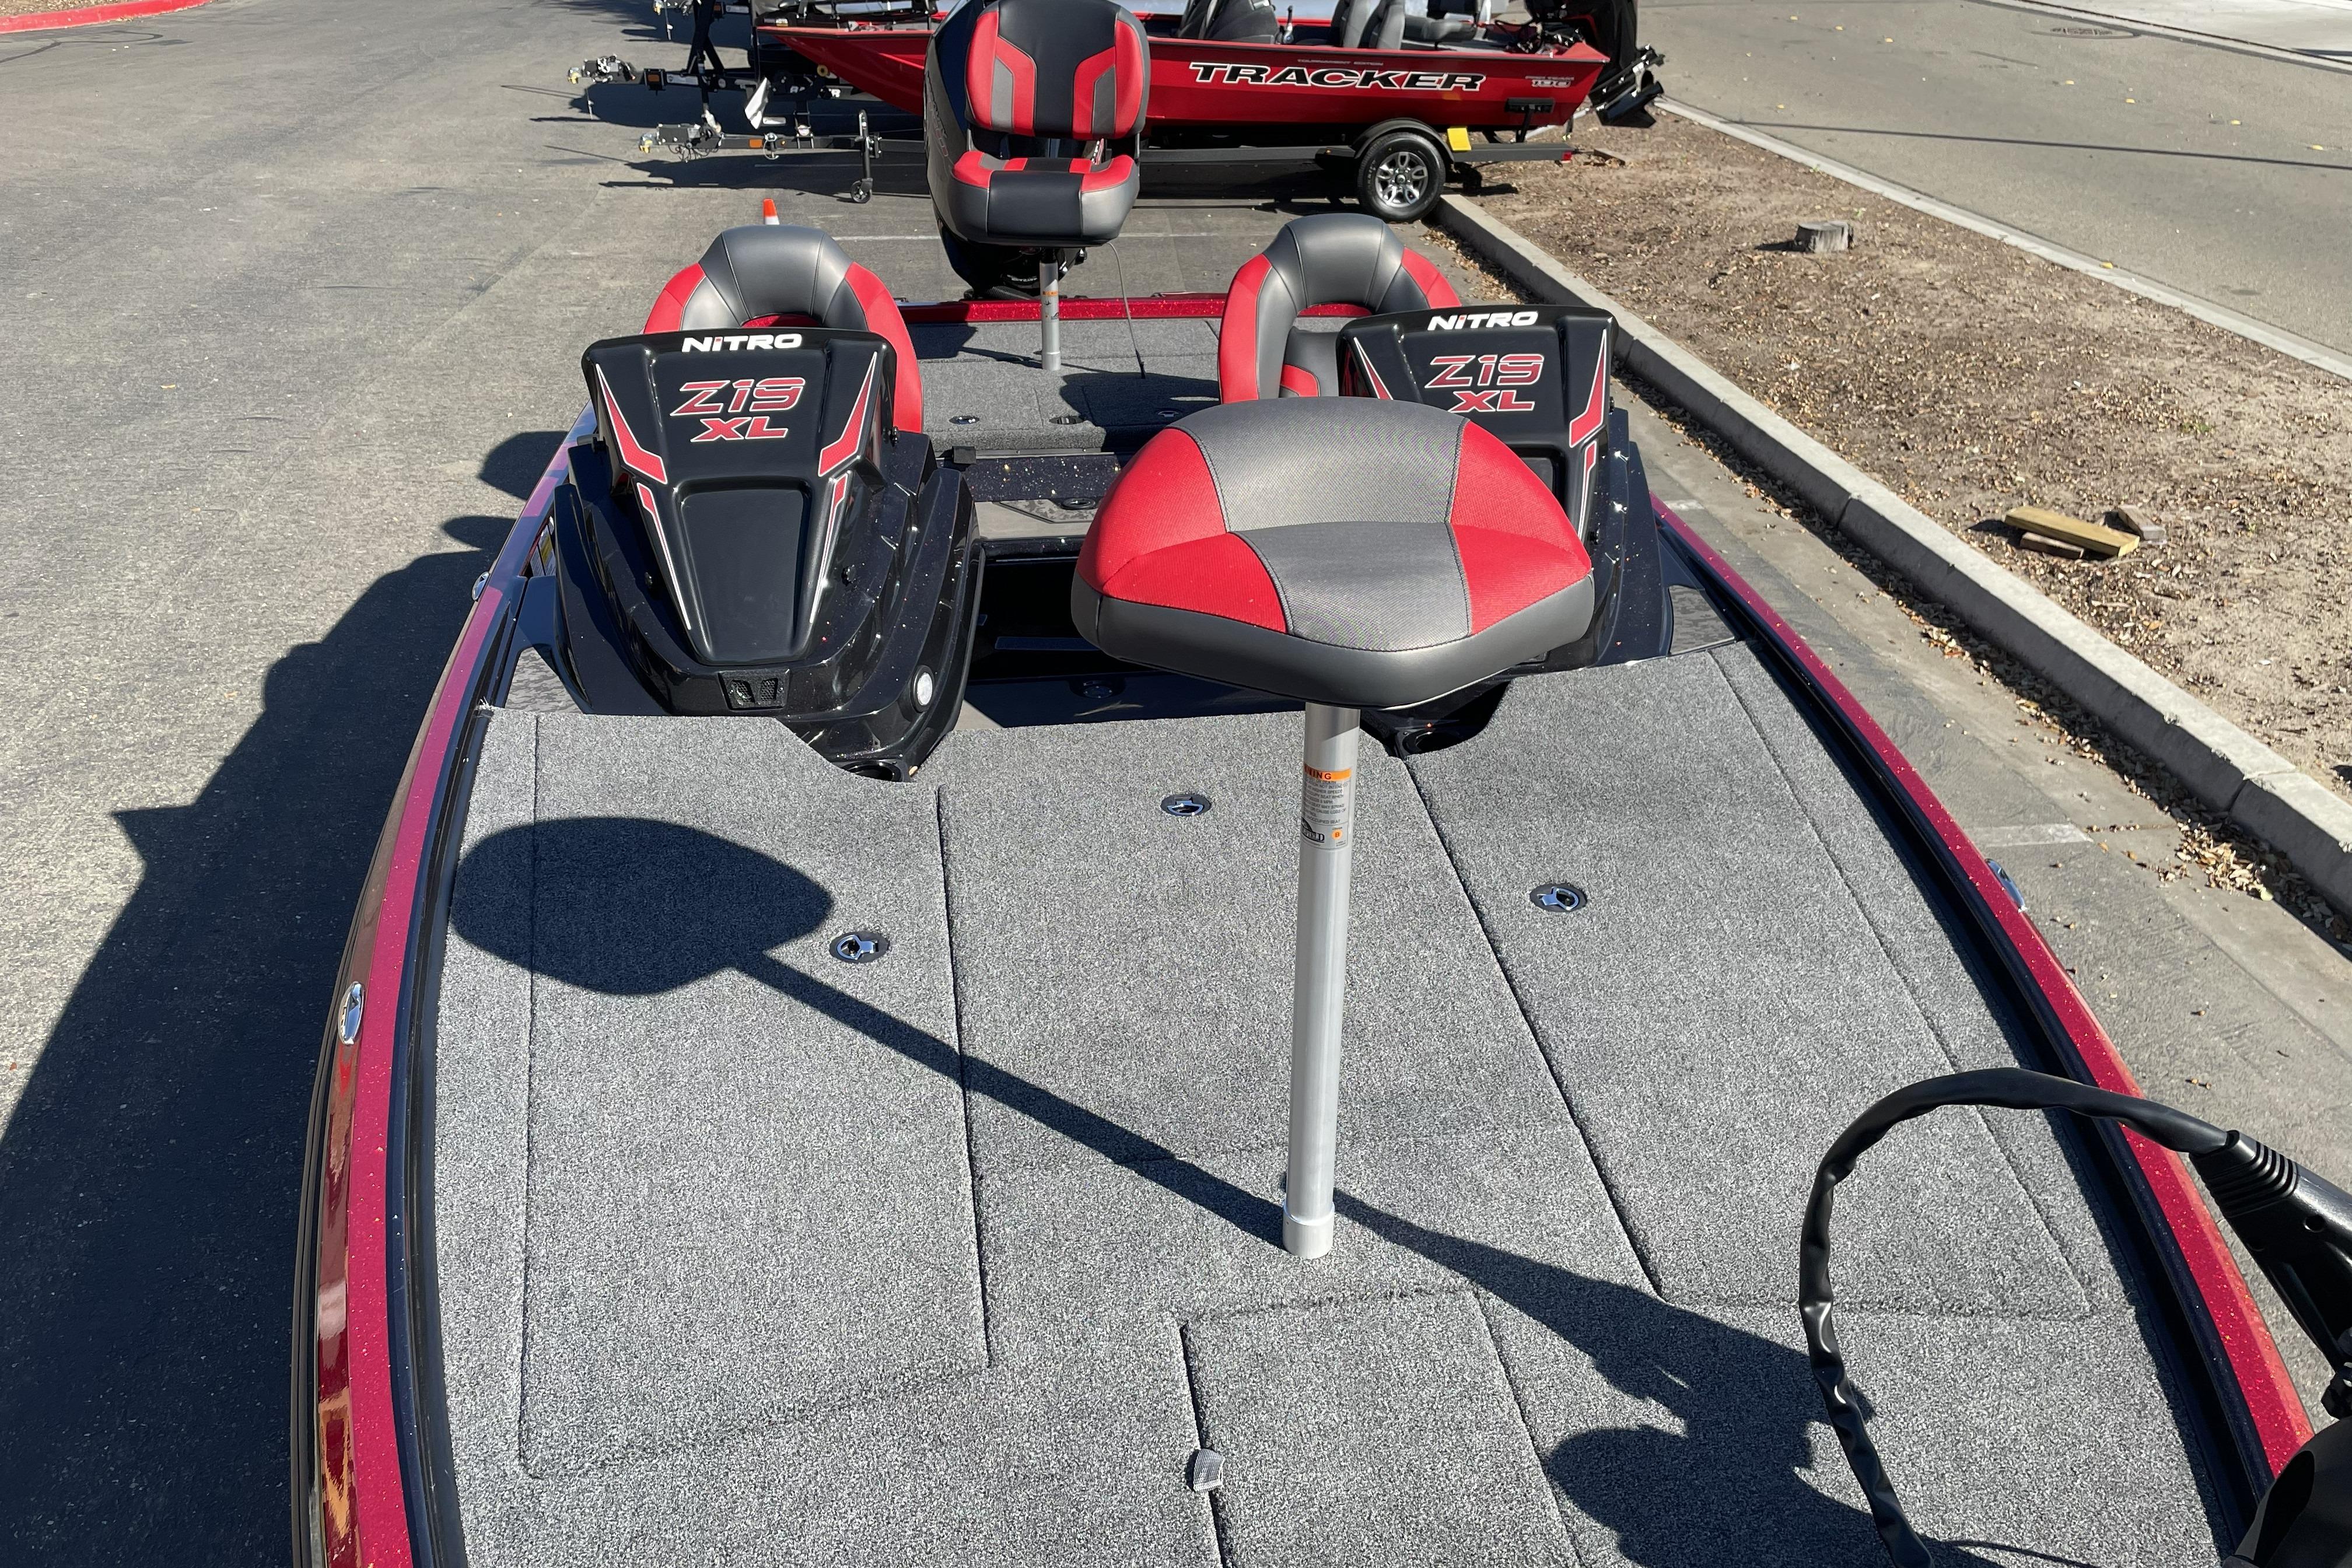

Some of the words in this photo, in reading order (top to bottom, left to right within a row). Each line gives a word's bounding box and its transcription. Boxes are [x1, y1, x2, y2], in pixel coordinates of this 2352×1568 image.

[1189, 61, 1487, 92] TRACKER
[1424, 354, 1545, 388] Z19
[670, 377, 806, 416] Z19
[1448, 390, 1535, 413] XL
[690, 416, 789, 443] XL
